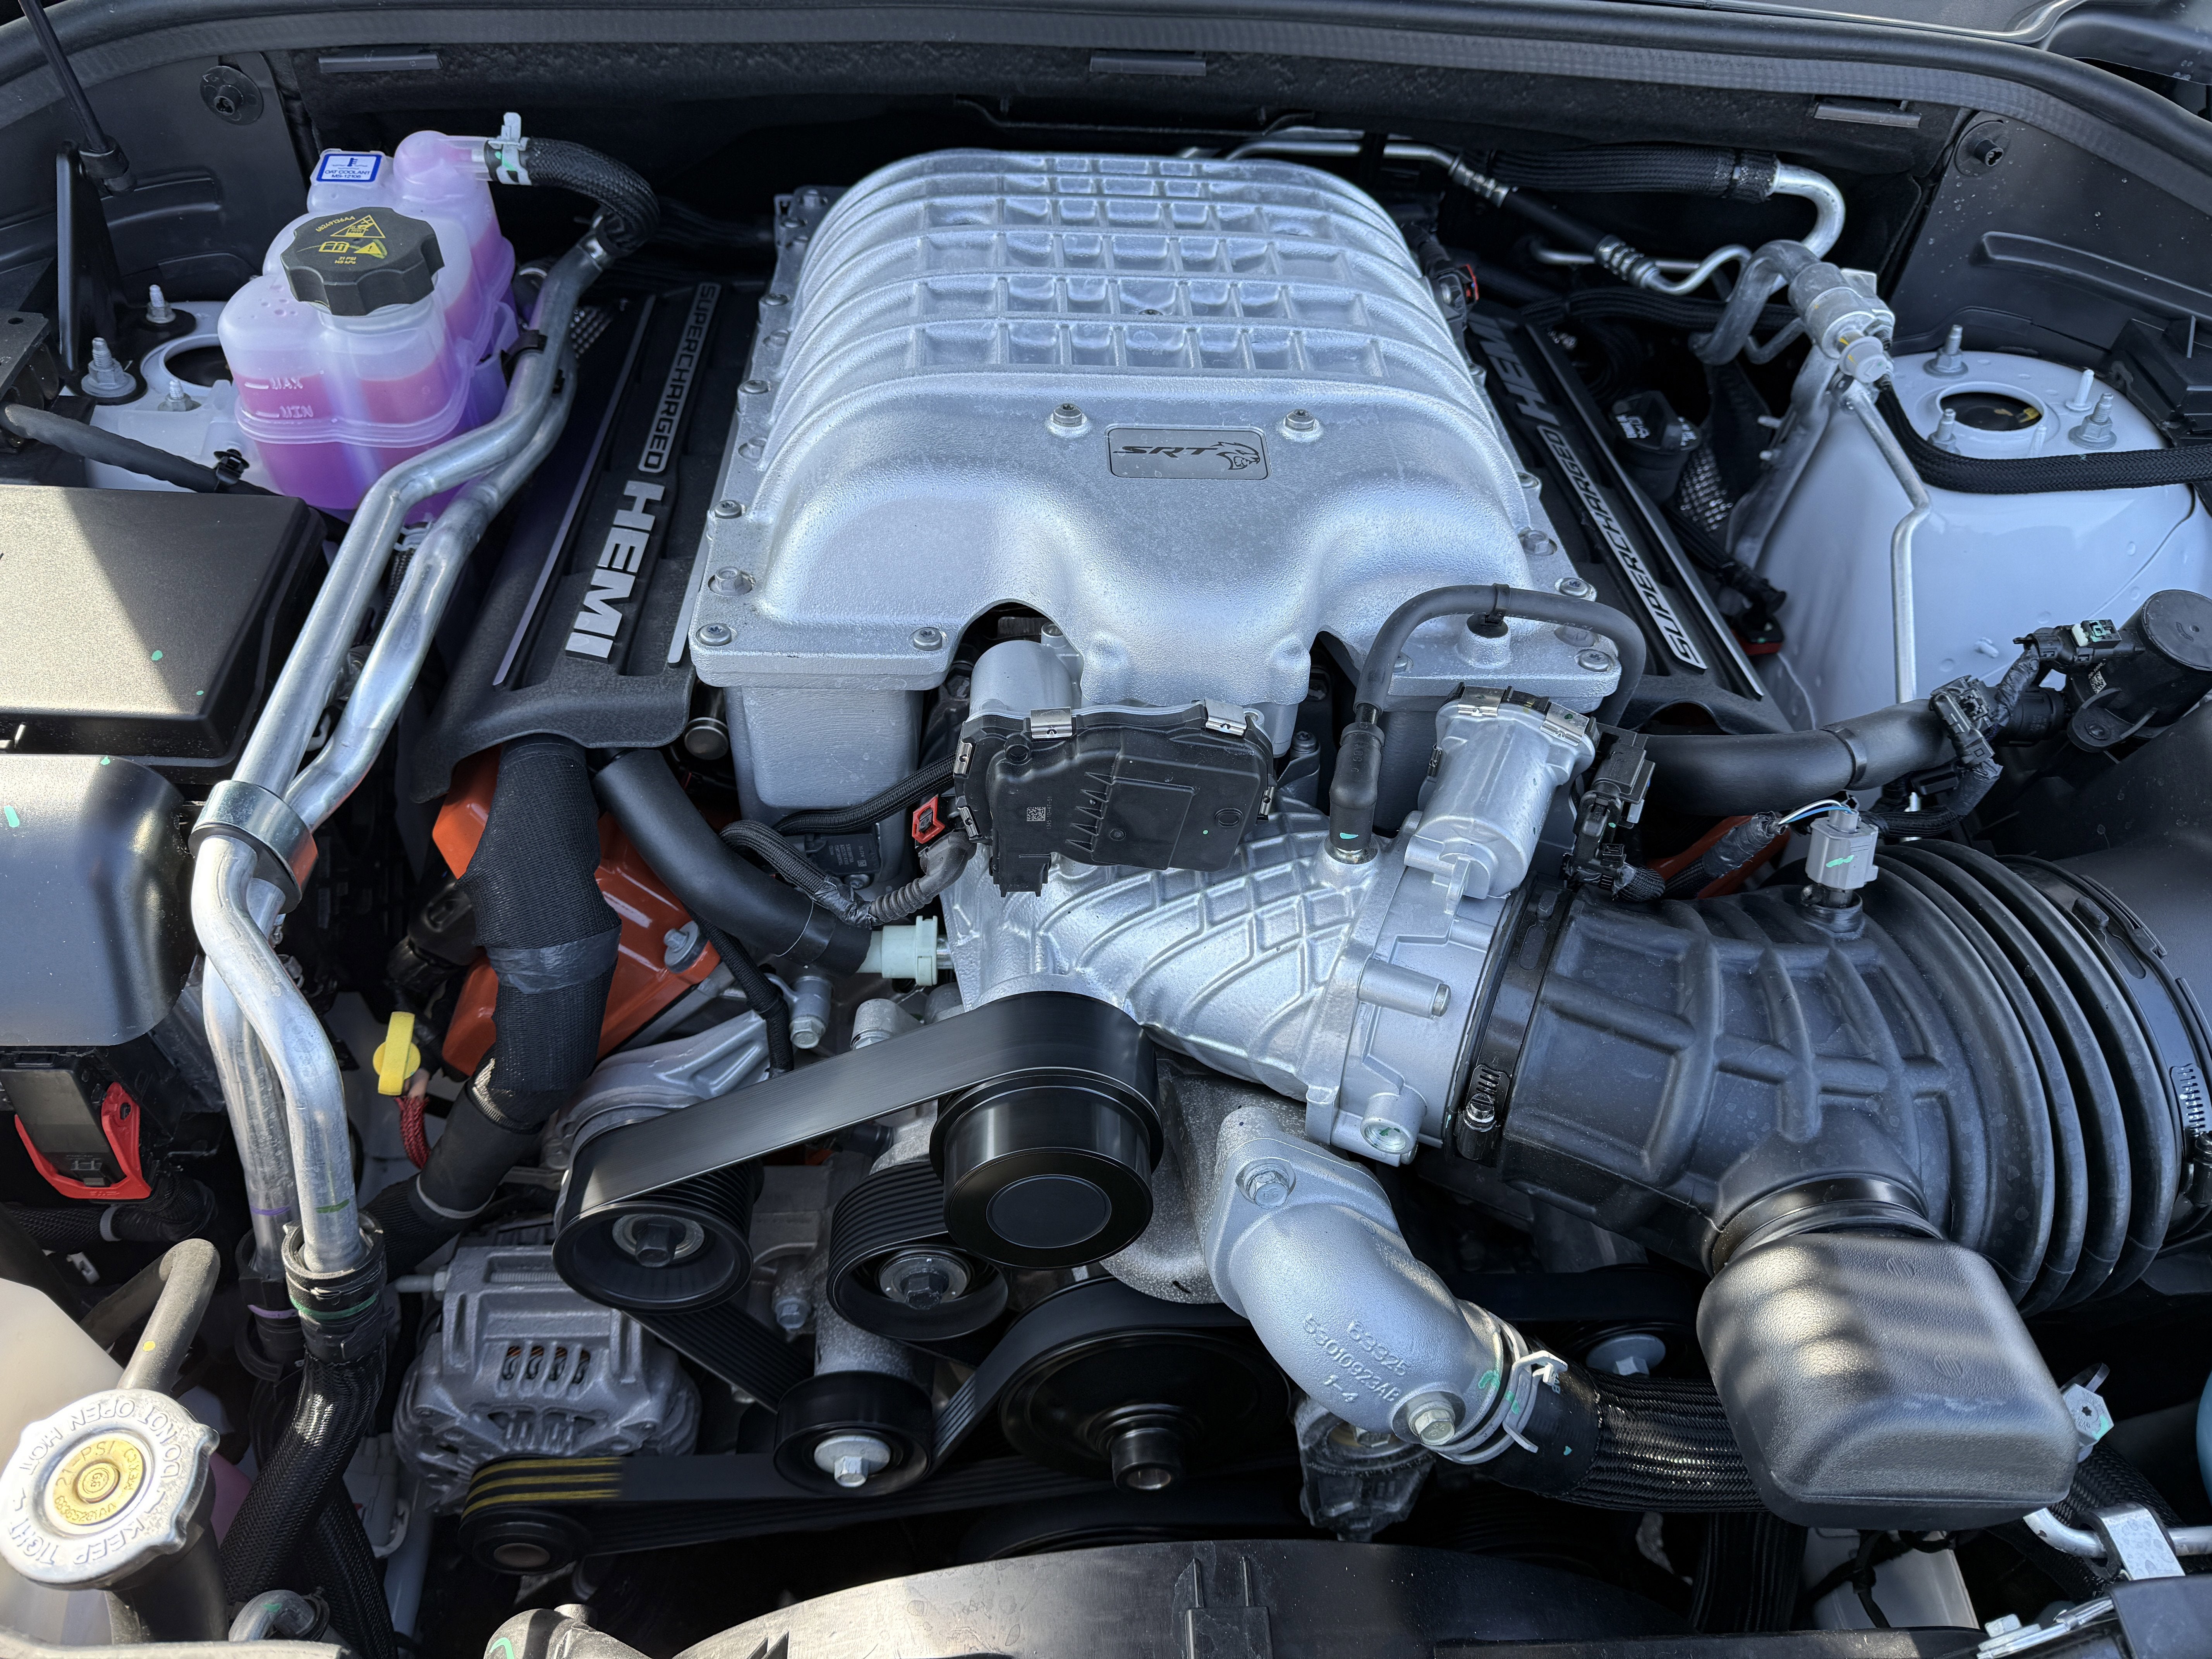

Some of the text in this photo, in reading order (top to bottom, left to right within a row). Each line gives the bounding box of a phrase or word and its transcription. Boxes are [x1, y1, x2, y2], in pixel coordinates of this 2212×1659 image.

[269, 377, 303, 390] MAX
[644, 285, 716, 471] SUPERCHARGED
[1468, 314, 1561, 426] HEMI
[279, 405, 313, 418] MIN
[1113, 446, 1218, 459] SRT
[566, 480, 665, 659] HEMI
[1549, 431, 1700, 664] SUPERCHARGED
[1348, 1321, 1412, 1376] 63325
[19, 1399, 182, 1479] DO NOT OPEN HOT
[7, 1518, 145, 1565] KEEP TIGHT
